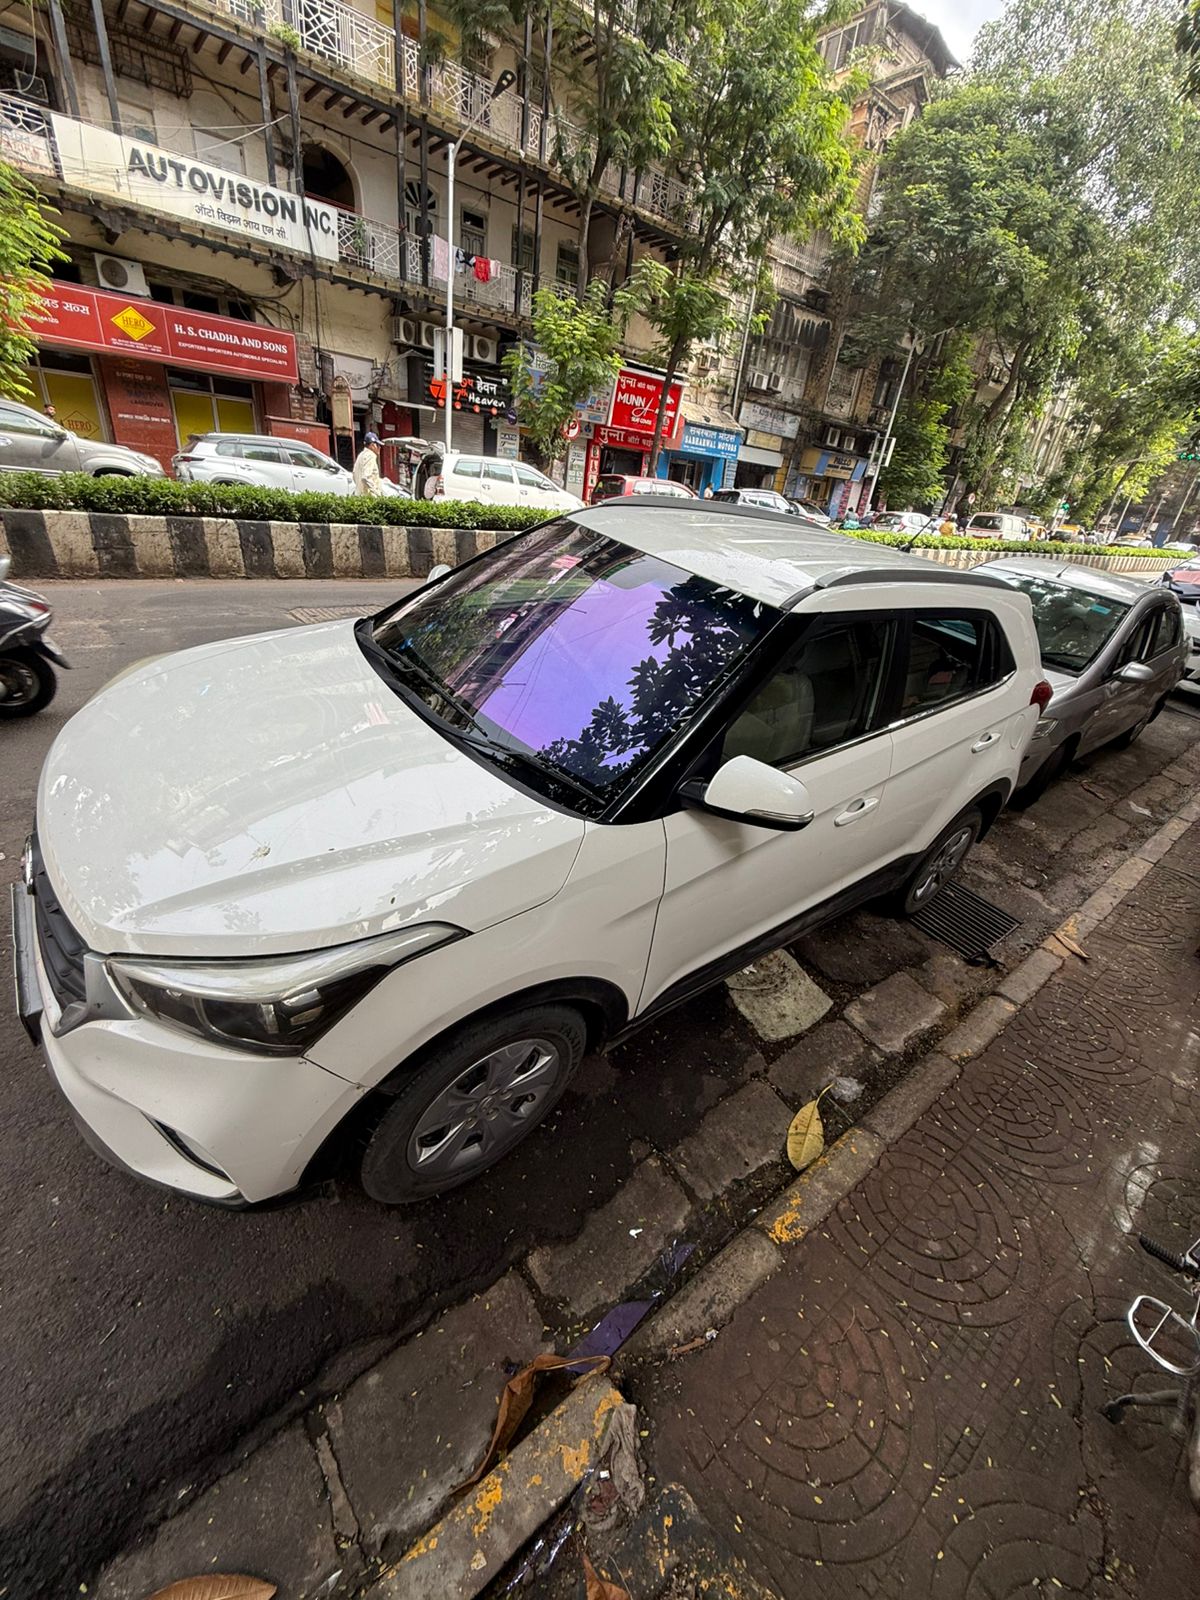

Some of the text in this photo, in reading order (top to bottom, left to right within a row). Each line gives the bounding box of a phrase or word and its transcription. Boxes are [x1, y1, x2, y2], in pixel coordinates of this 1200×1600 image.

[128, 147, 335, 236] AUTOVISION INC.
[243, 219, 260, 232] आय
[62, 300, 90, 315] सन्स
[121, 315, 146, 329] HERO
[174, 323, 288, 354] H. S. CHADHA AND SONS
[476, 375, 498, 395] हेवन
[468, 392, 506, 408] Heaven
[67, 419, 92, 432] HERO
[599, 427, 626, 444] मुन्ना
[718, 442, 738, 452] MOTORS
